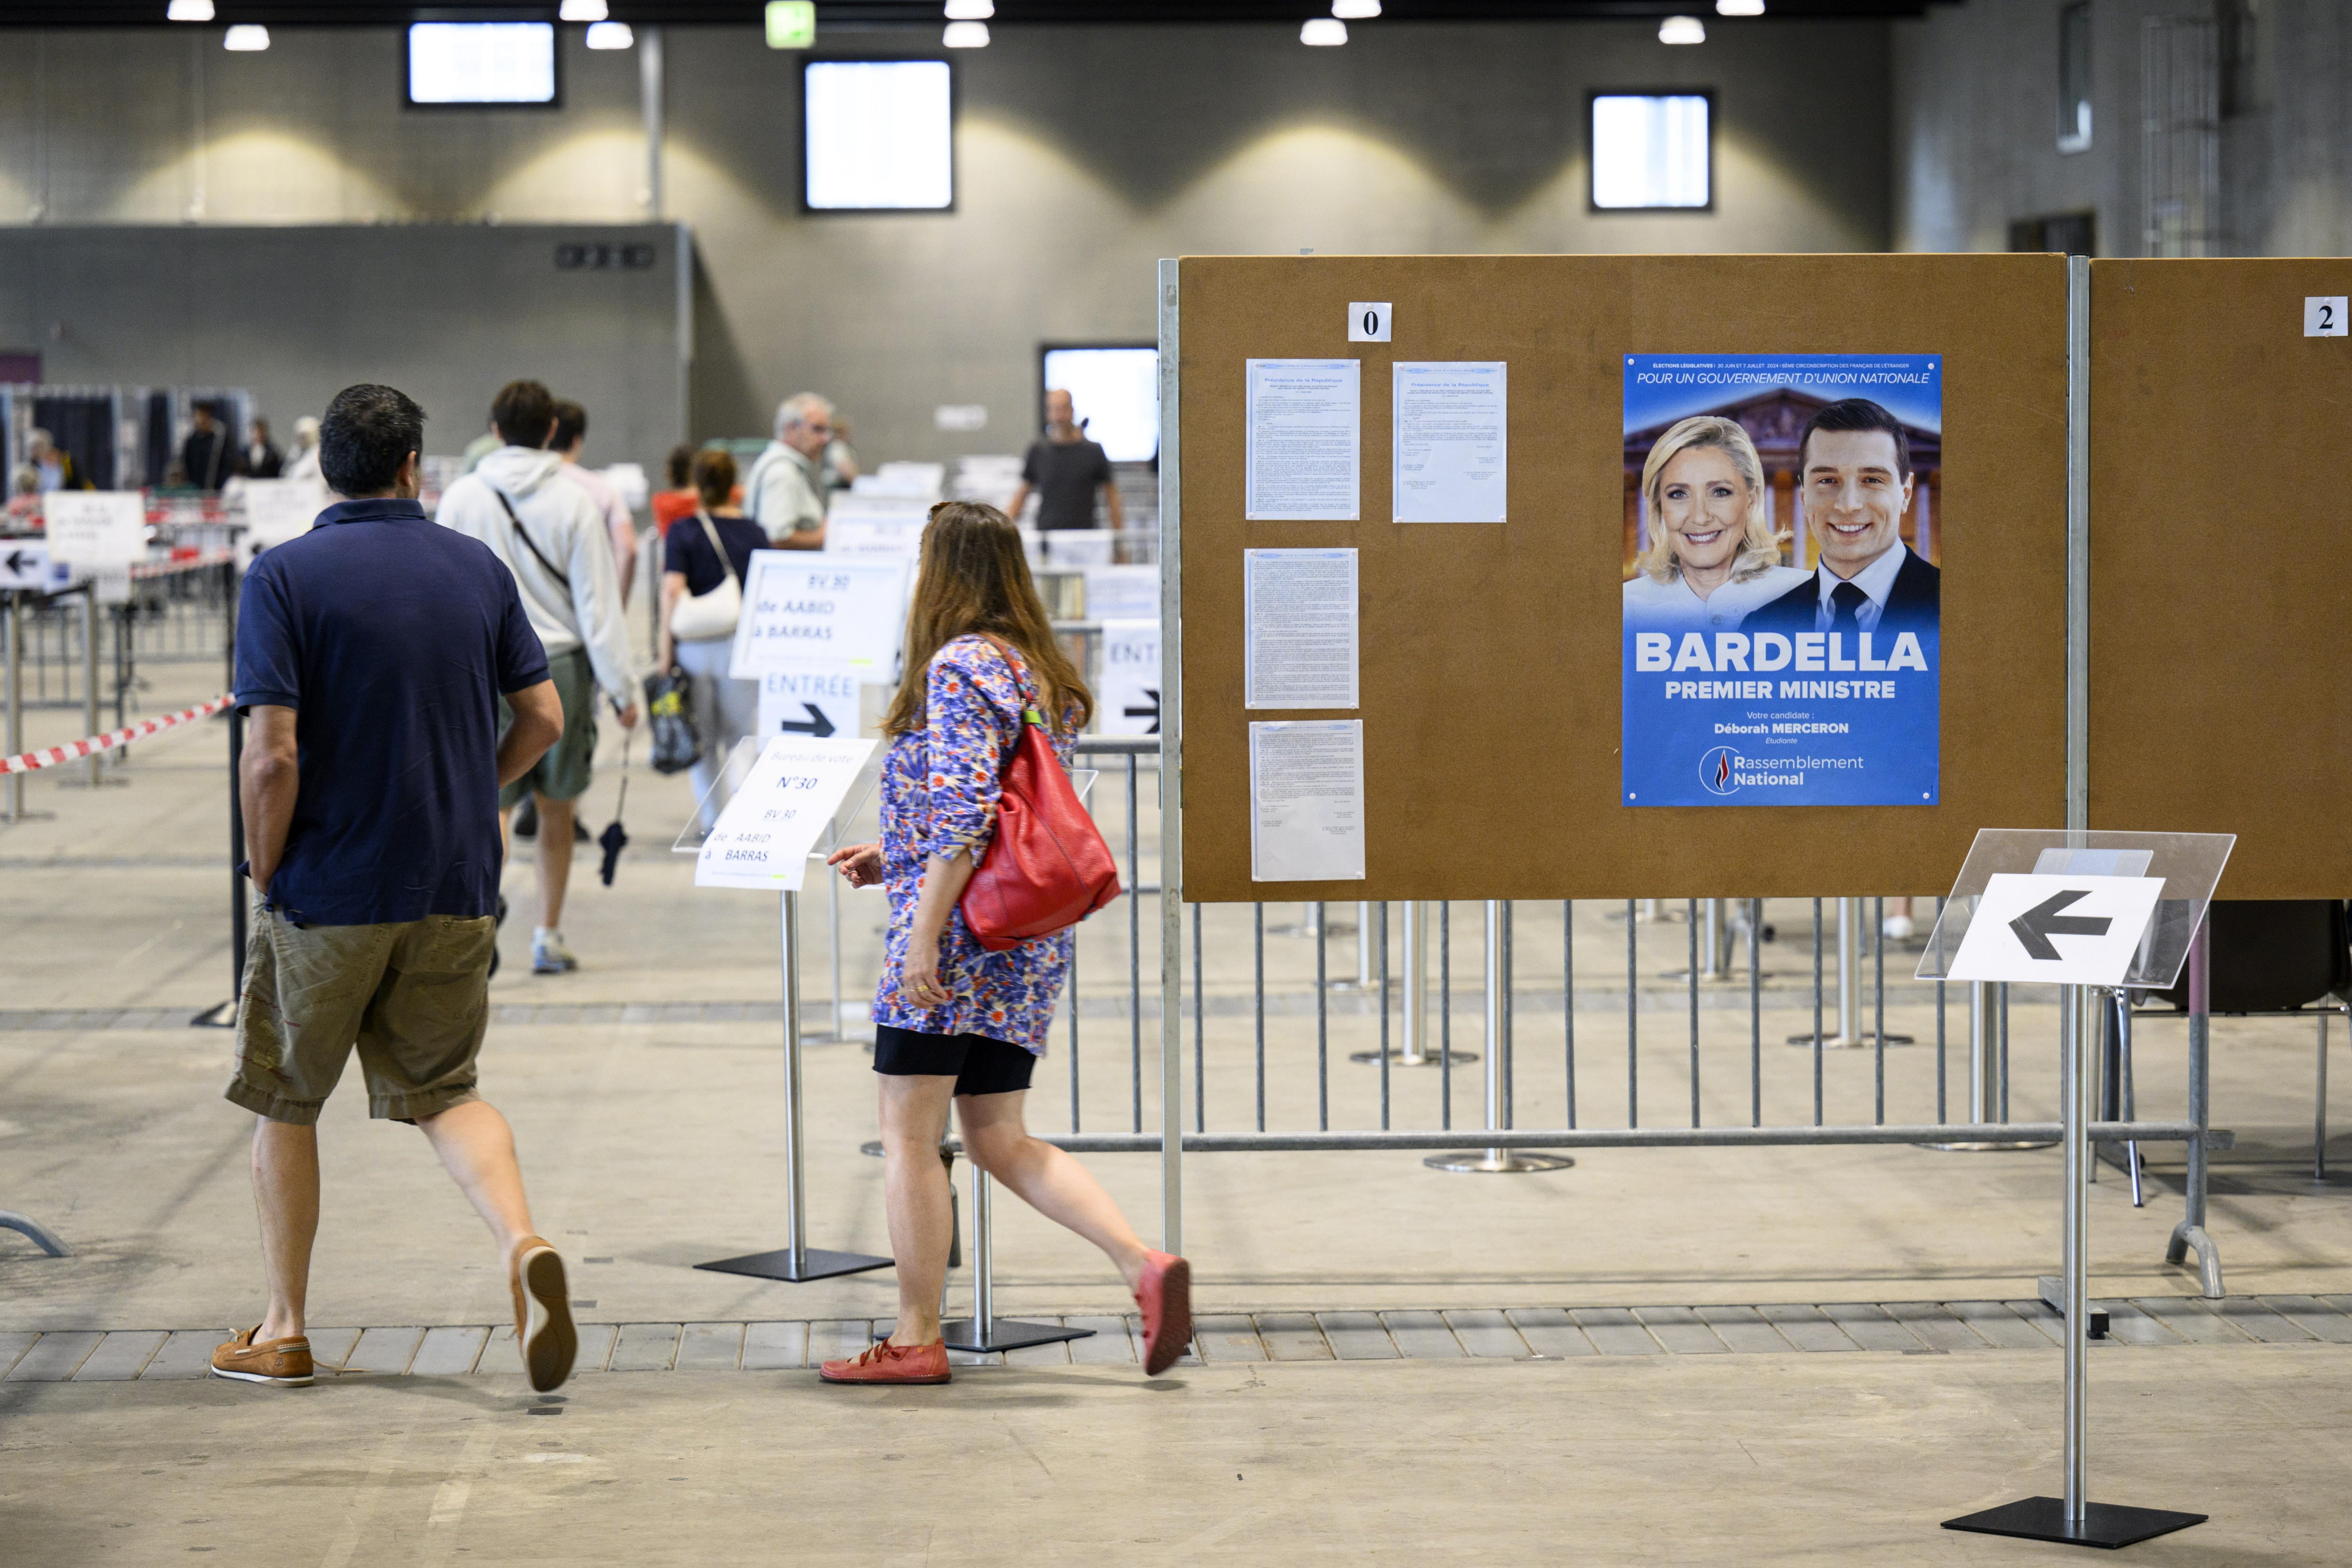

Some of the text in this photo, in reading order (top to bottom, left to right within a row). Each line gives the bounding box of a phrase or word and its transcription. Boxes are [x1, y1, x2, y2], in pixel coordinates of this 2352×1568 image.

[1363, 311, 1378, 335] 0
[2319, 305, 2333, 329] 2
[1637, 373, 1673, 384] POUR
[1676, 373, 1695, 384] UN
[1697, 373, 1802, 384] GOUVERNEMENT
[1859, 373, 1930, 384] NATIONALE
[808, 573, 829, 588] BV
[1109, 642, 1156, 663] ENT
[1636, 632, 1928, 672] BARDELLA
[767, 672, 854, 697] ENTRÉE
[1666, 680, 1896, 699] PREMIER MINISTRE
[1714, 723, 1849, 734] Déborah MERCERON
[771, 751, 854, 763] Bureau de vote
[1734, 755, 1864, 770] Rassemblement
[776, 776, 818, 789] N°30
[1734, 771, 1804, 786] National
[764, 809, 796, 820] BV 30
[714, 832, 771, 843] de AABID
[705, 849, 770, 862] à BARRAS
